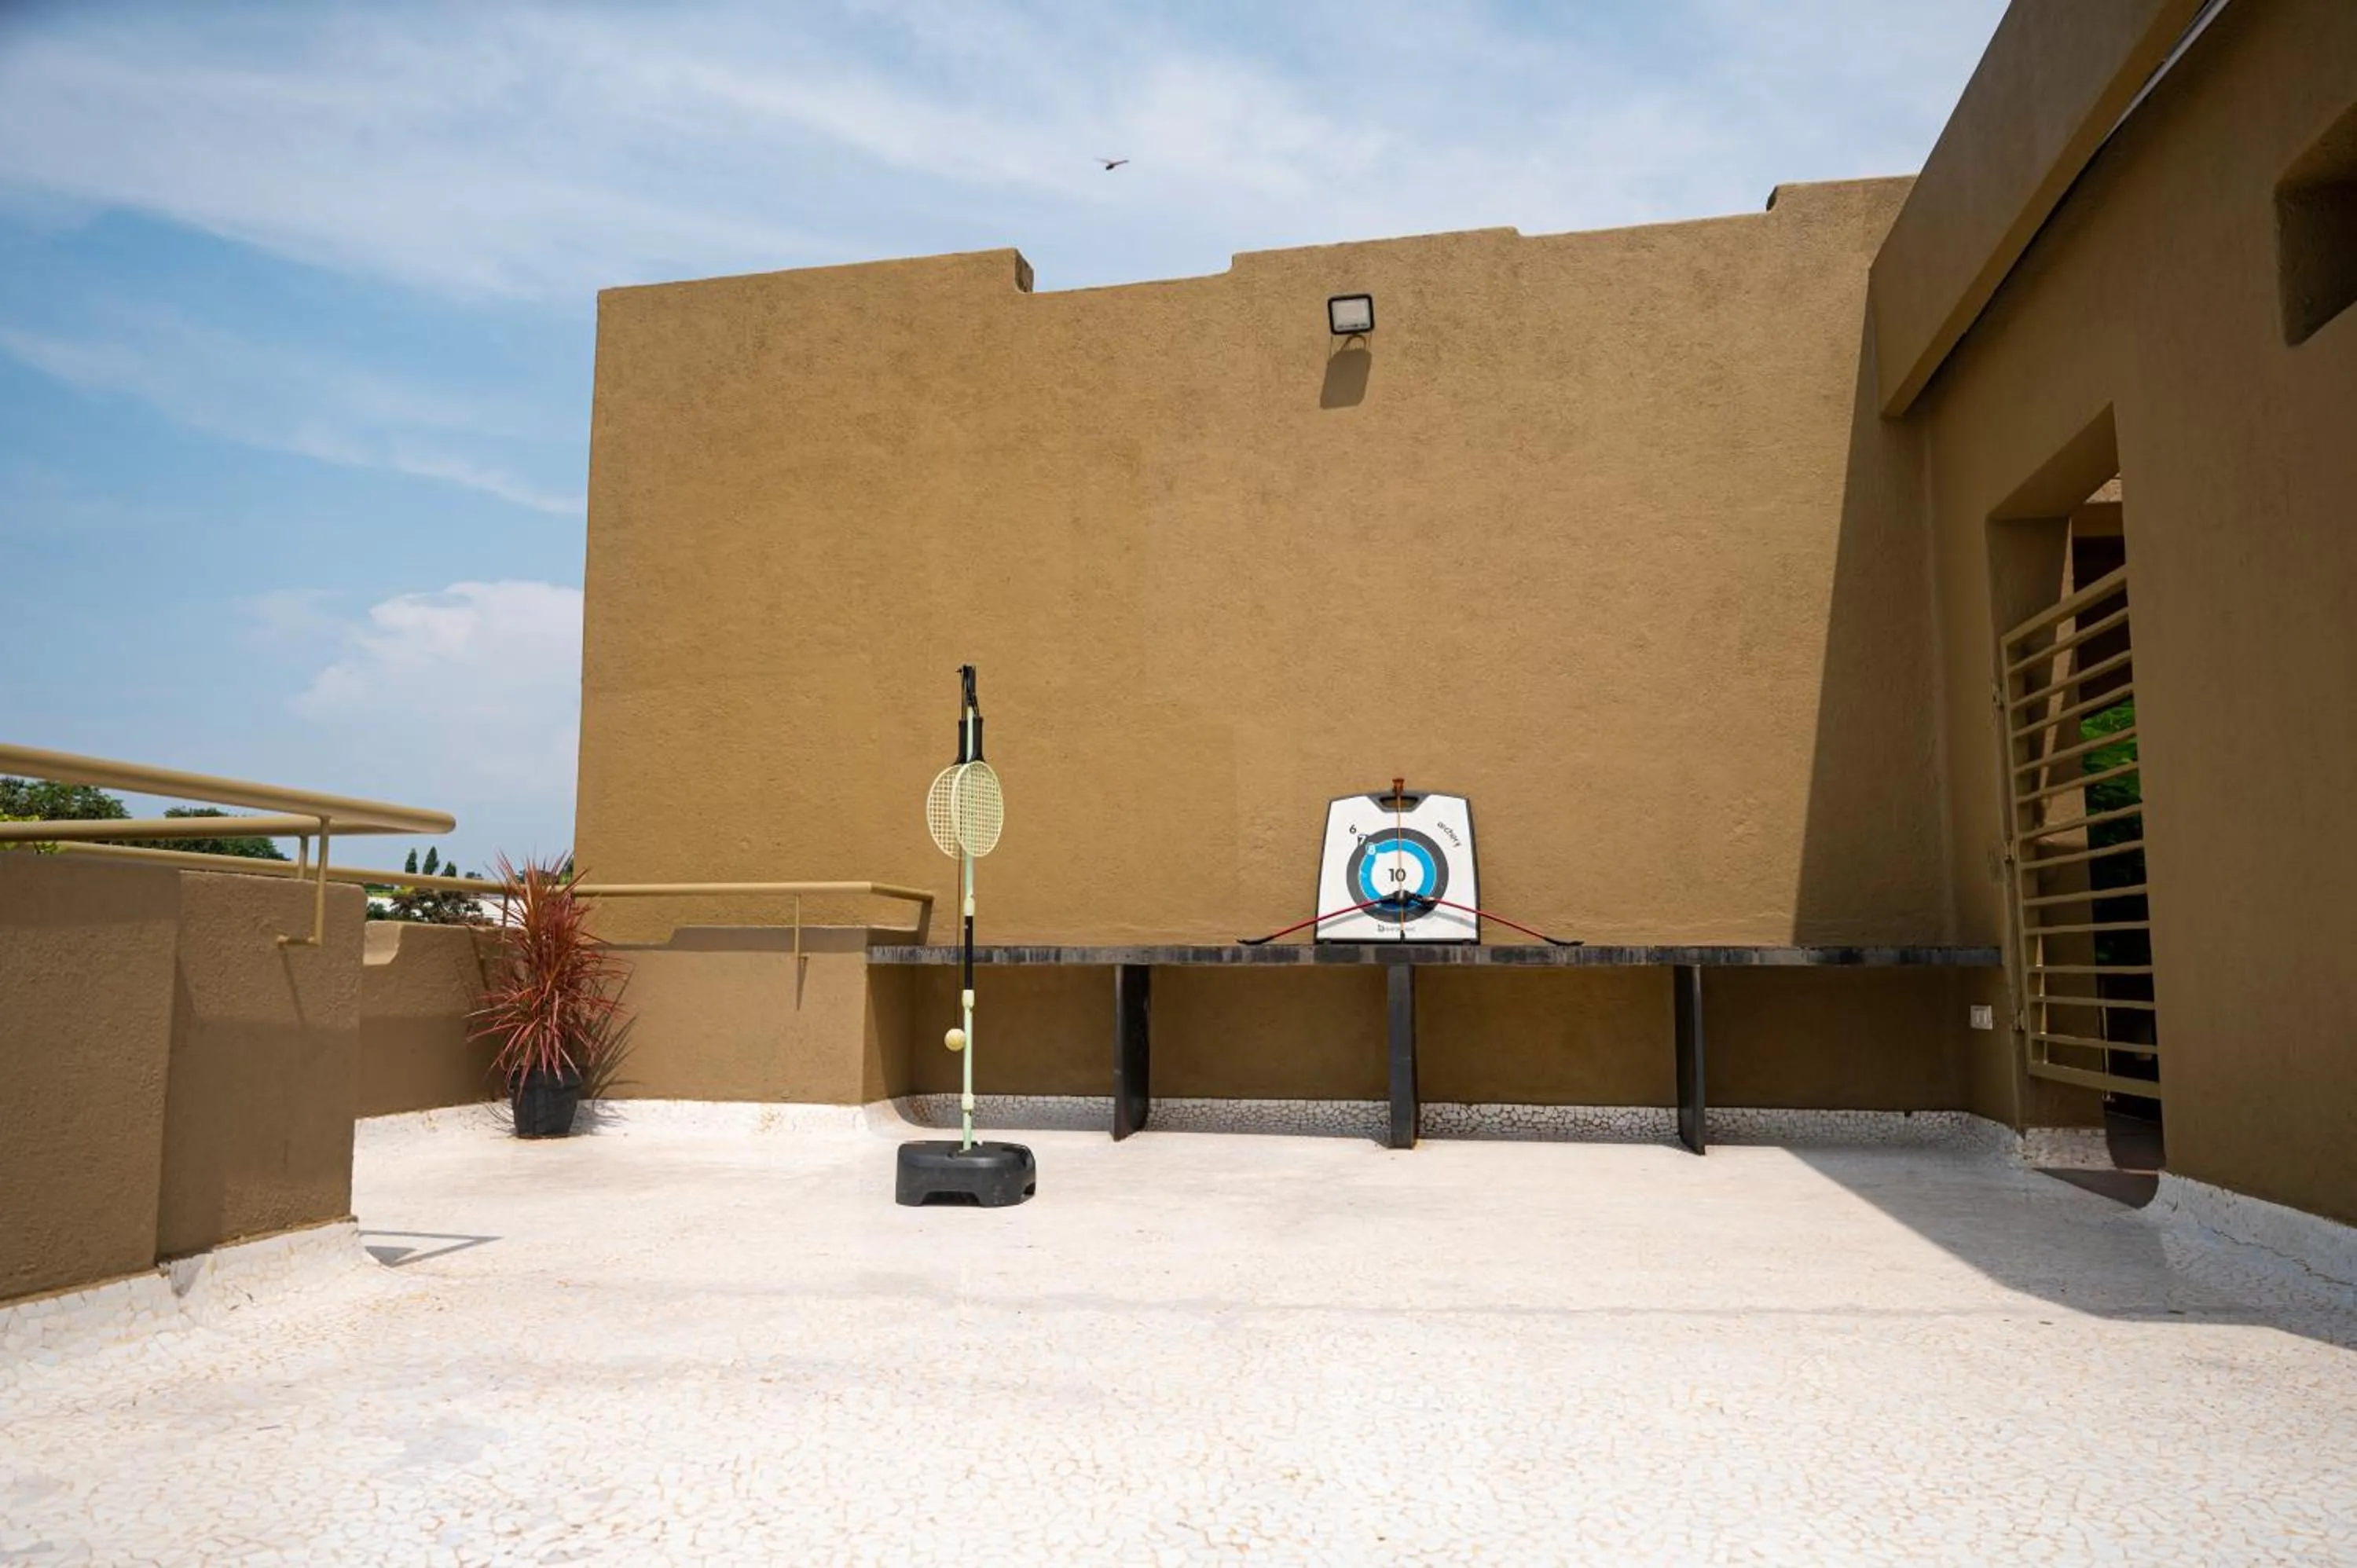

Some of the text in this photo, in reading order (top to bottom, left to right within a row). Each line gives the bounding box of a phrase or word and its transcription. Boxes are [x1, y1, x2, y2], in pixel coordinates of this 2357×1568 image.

[1349, 824, 1357, 834] 6
[1358, 835, 1366, 845] 7
[1387, 868, 1406, 882] 10
